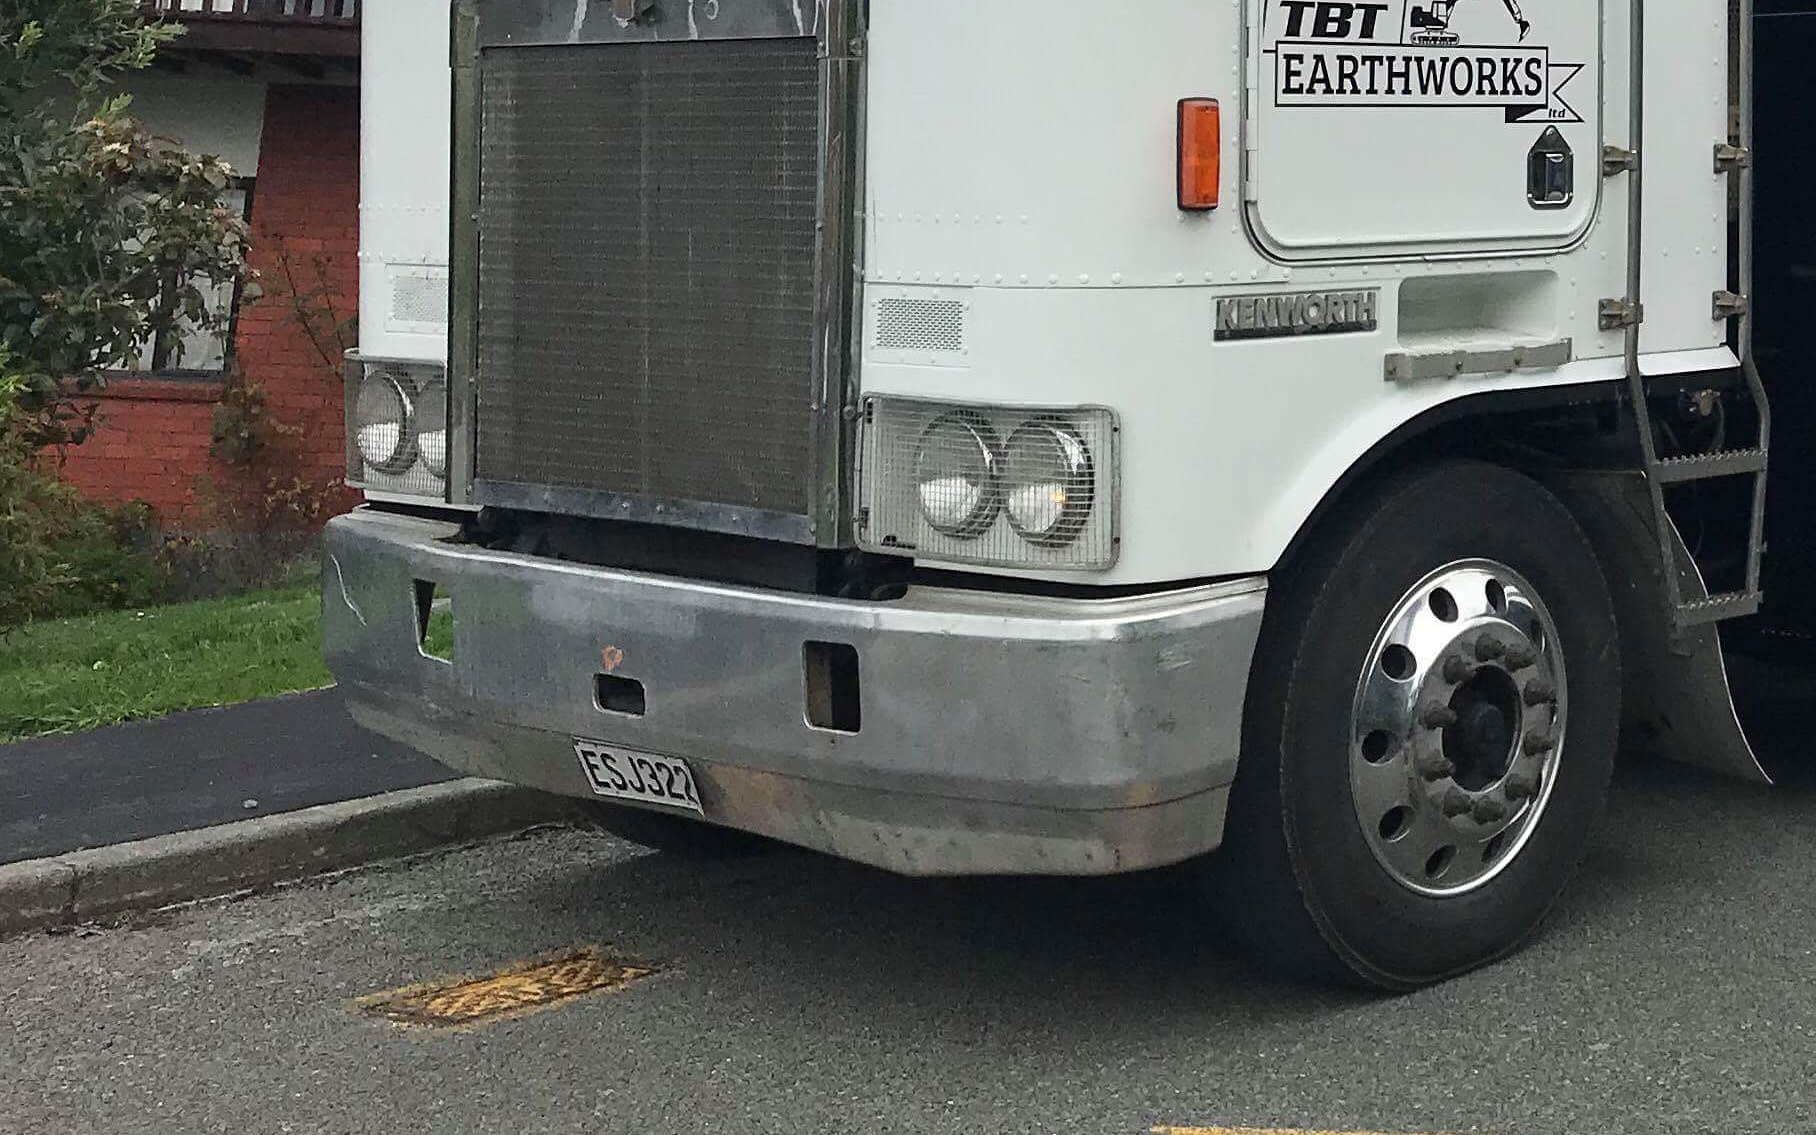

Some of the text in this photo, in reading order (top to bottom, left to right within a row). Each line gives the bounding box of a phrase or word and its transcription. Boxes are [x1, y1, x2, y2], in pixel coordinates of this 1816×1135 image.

[1280, 0, 1388, 39] TBT
[1282, 53, 1543, 96] EARTHWORKS
[1548, 108, 1566, 118] ltd
[1216, 291, 1377, 331] KENWORTH
[581, 749, 699, 806] ESJ322
